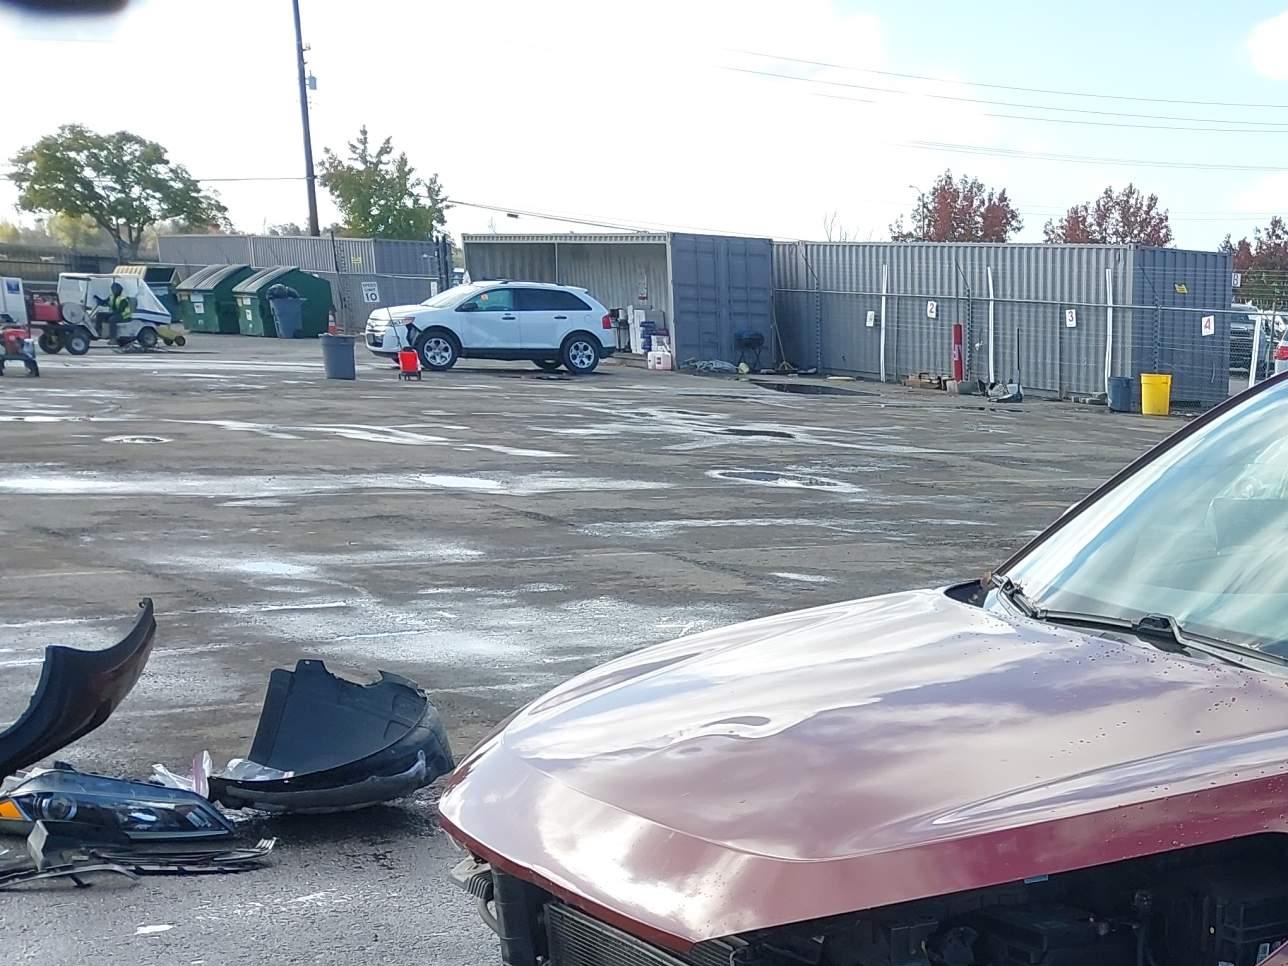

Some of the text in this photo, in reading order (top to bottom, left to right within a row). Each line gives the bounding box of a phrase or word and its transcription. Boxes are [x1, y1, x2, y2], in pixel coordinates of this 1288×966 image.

[365, 292, 378, 301] 10
[929, 302, 935, 314] 2
[1068, 310, 1075, 323] 3
[1203, 317, 1211, 331] 4
